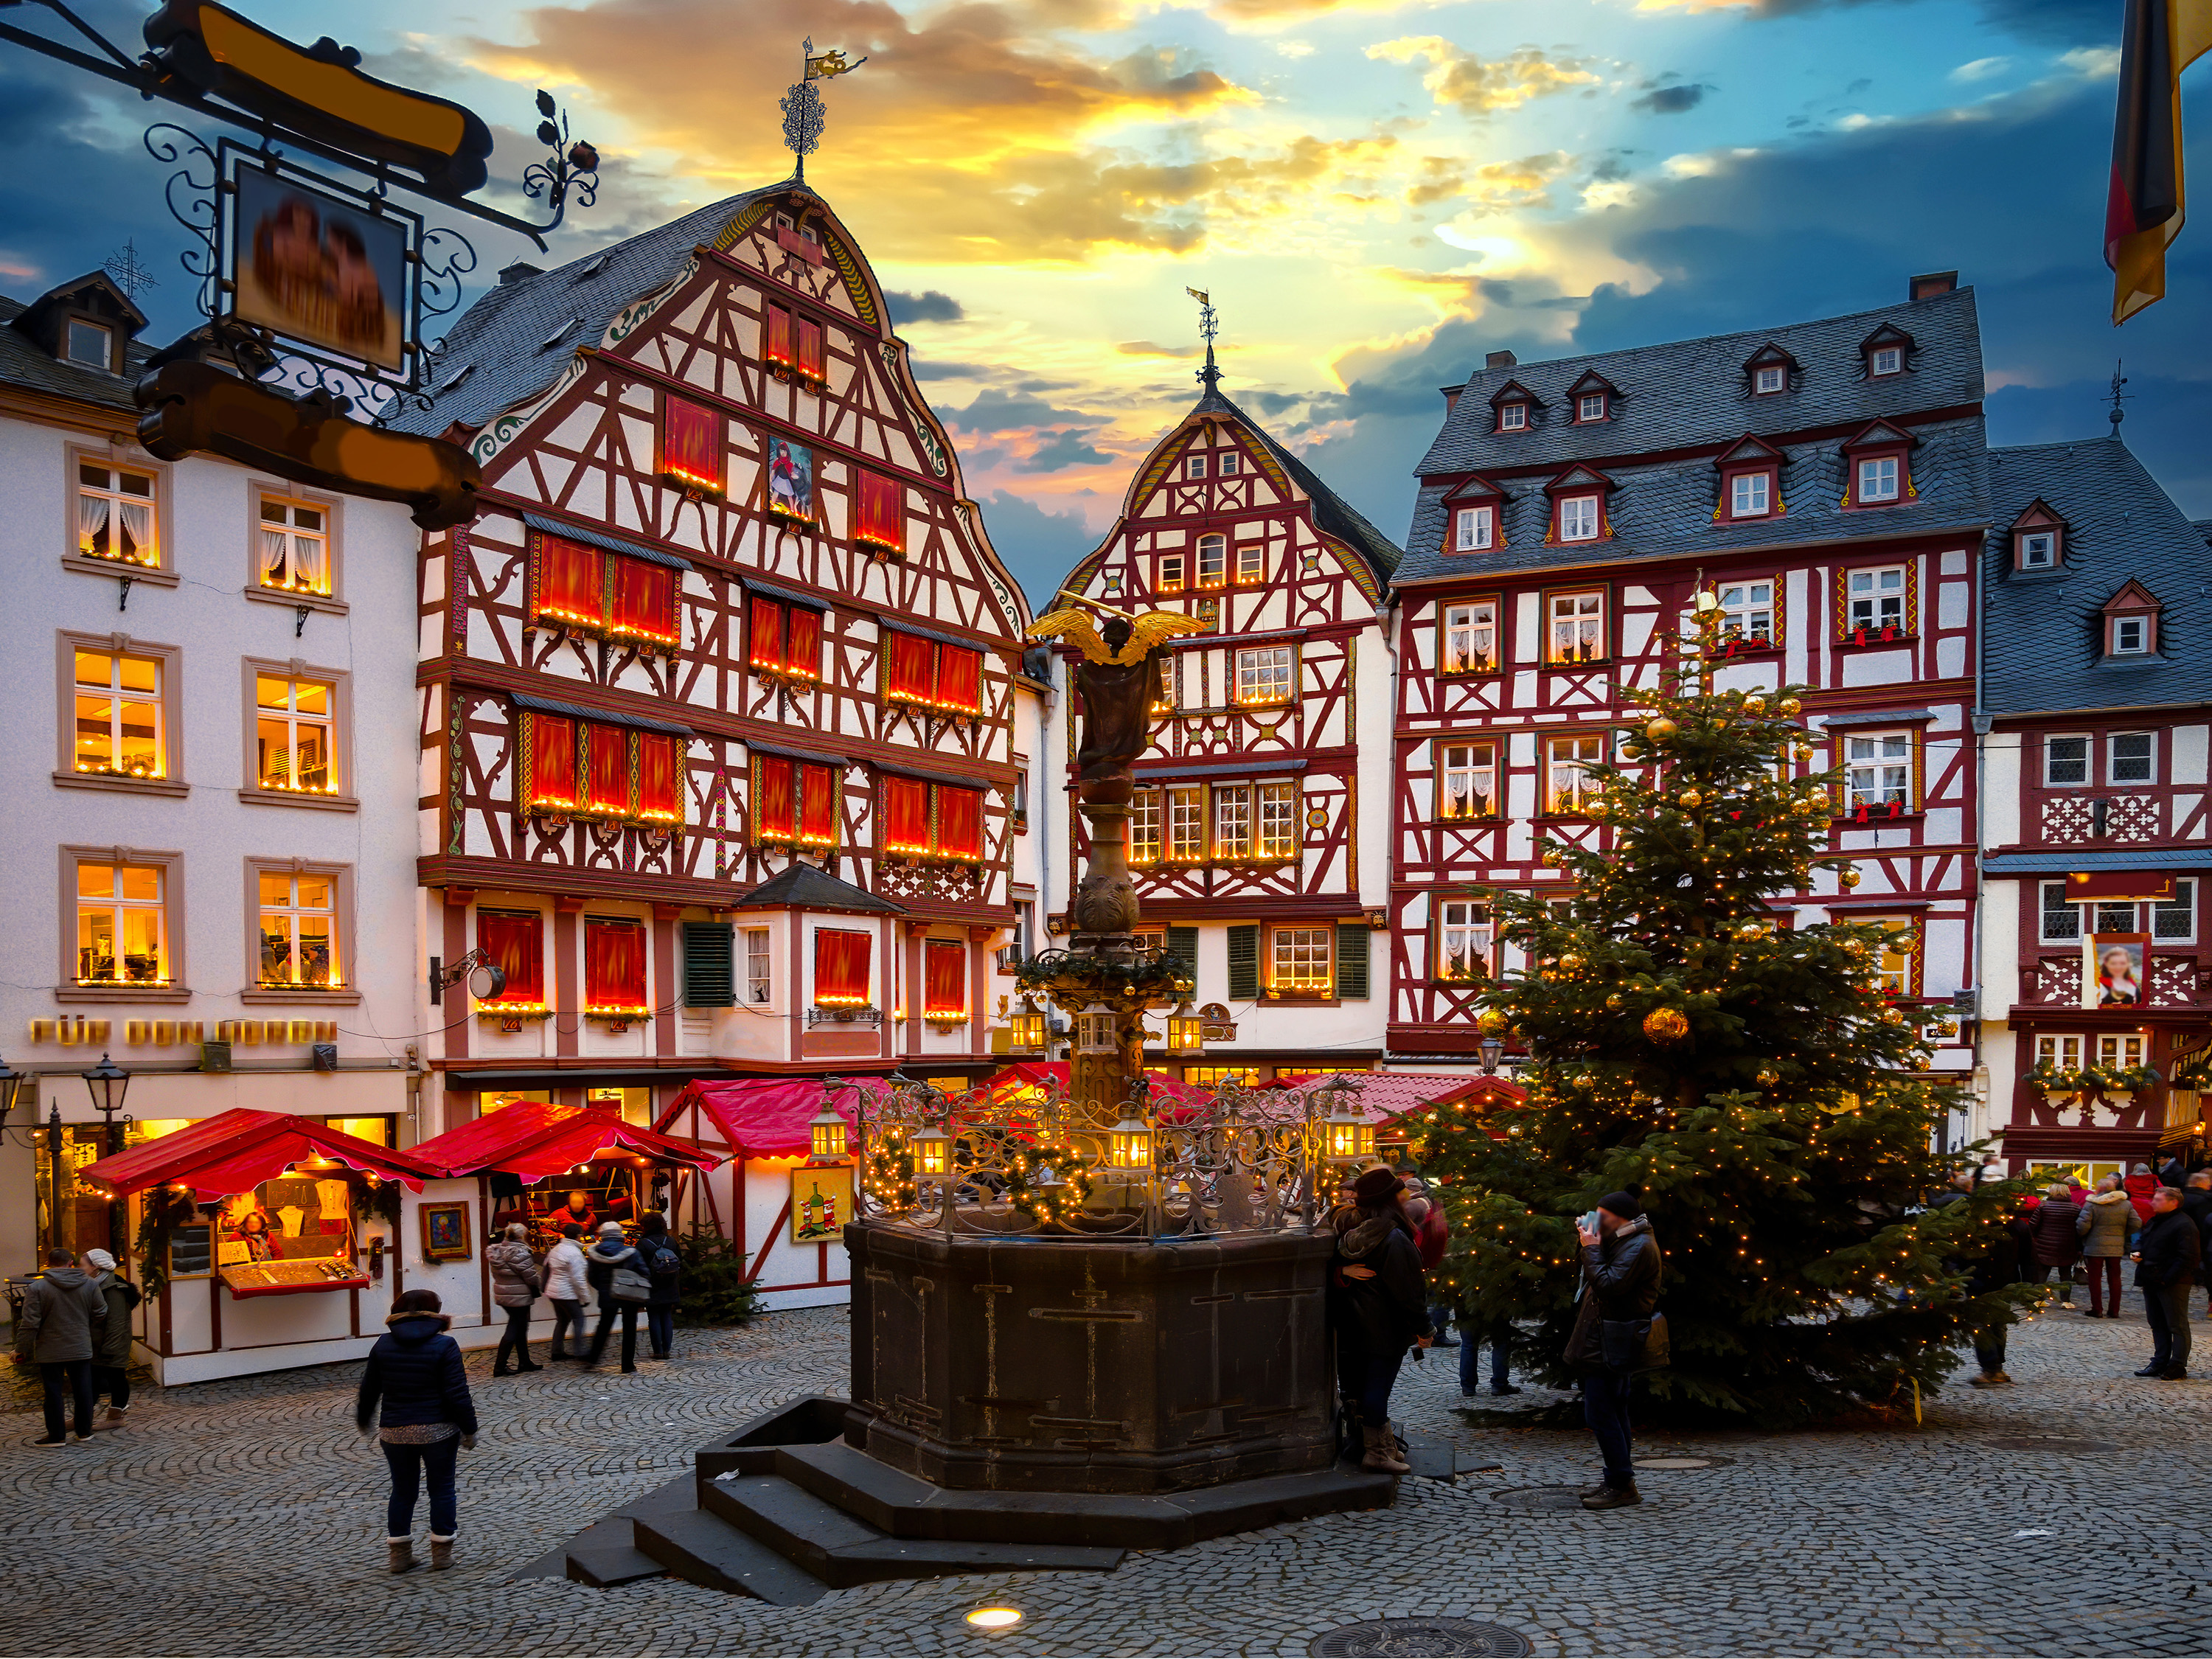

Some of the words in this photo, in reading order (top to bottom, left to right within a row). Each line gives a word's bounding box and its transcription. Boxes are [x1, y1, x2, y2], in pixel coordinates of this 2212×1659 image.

[776, 370, 788, 378] 19
[807, 382, 818, 392] 20
[687, 490, 702, 499] 12
[878, 552, 886, 560] 6
[641, 645, 652, 655] 5
[798, 683, 810, 692] 13
[957, 715, 966, 724] 18
[552, 814, 568, 824] 10
[609, 820, 618, 830] 8
[658, 827, 665, 837] 9
[775, 845, 786, 854] 21
[909, 858, 916, 866] 3
[504, 1019, 519, 1029] 16
[612, 1020, 626, 1029] 15
